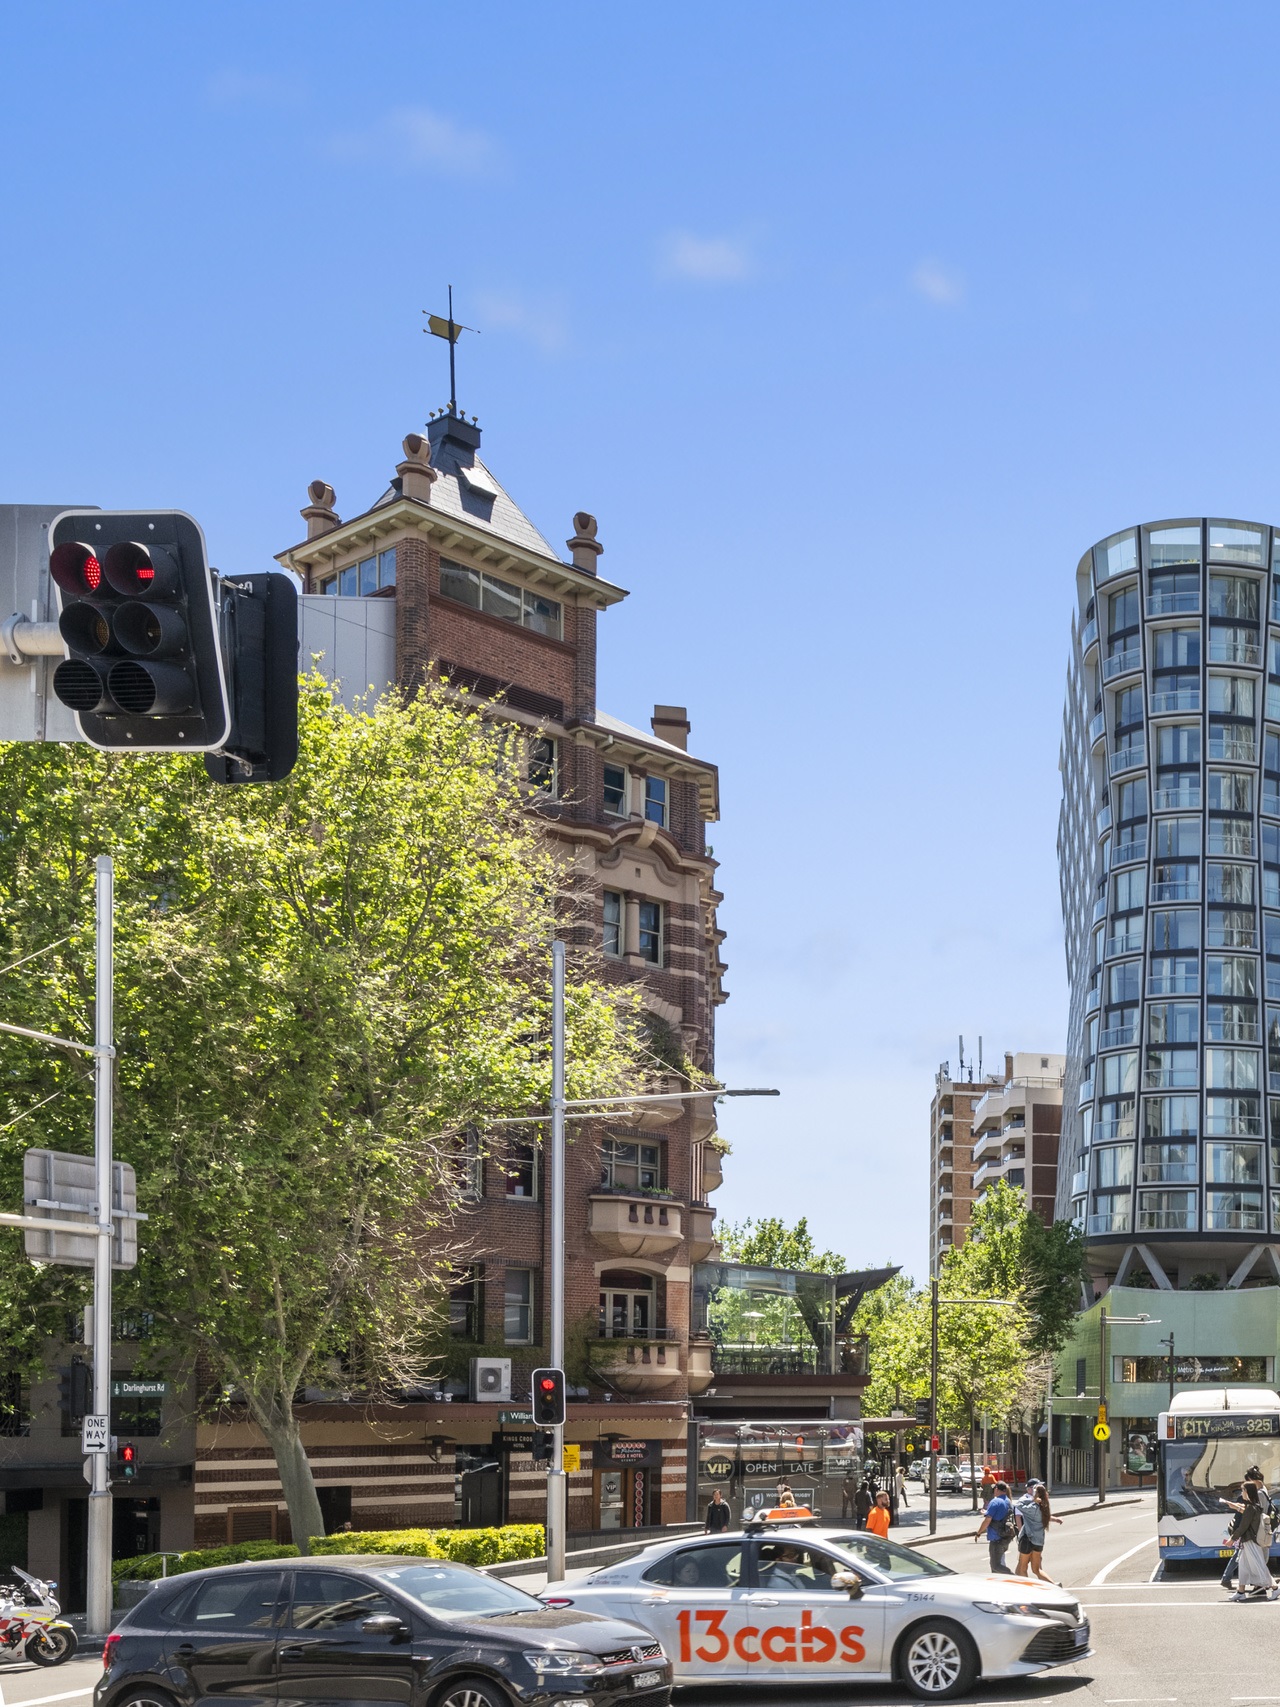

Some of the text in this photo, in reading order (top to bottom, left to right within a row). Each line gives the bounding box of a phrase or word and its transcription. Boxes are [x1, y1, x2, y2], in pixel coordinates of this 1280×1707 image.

[123, 1383, 165, 1394] Darlinghurst Rd
[87, 1418, 106, 1428] ONE
[1184, 1420, 1212, 1434] CITY
[1246, 1418, 1271, 1432] 325
[85, 1430, 107, 1440] WAY
[835, 1458, 851, 1466] VIP
[706, 1462, 732, 1474] VIP
[745, 1463, 814, 1473] OPEN LATE
[676, 1609, 866, 1663] 13cabs
